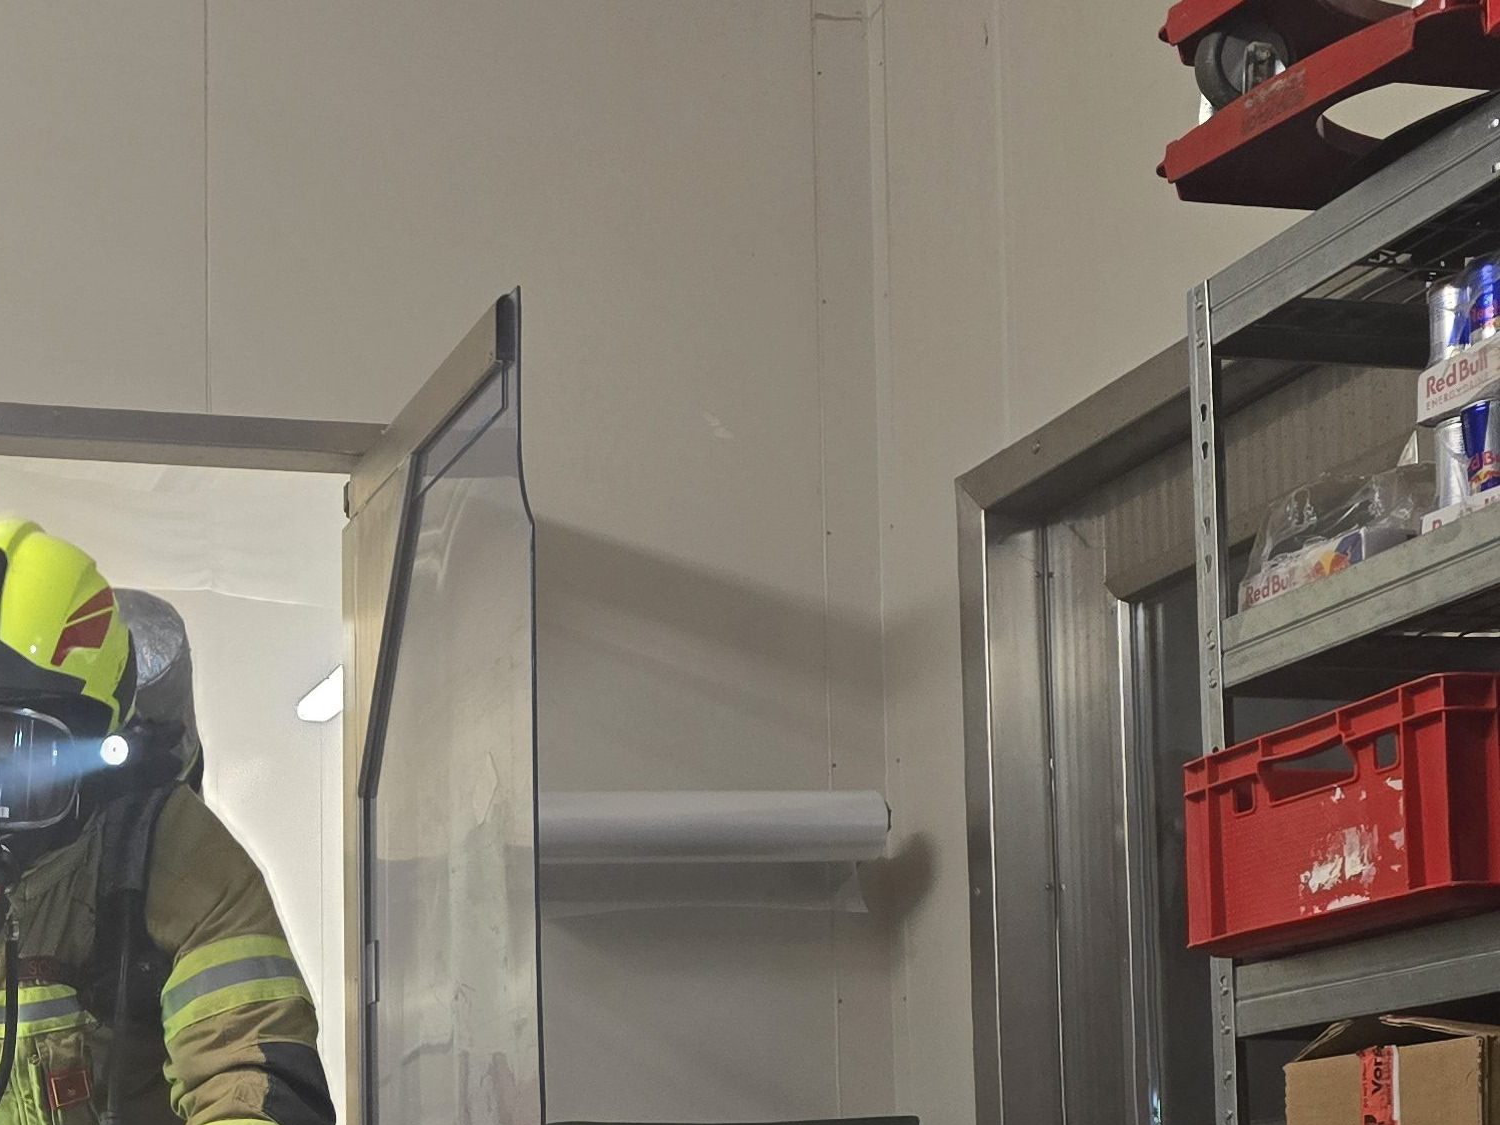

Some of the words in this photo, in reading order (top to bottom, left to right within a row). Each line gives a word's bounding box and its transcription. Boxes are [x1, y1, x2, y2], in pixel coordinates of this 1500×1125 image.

[1426, 363, 1457, 399] Red
[1459, 347, 1488, 382] Bull
[1245, 577, 1270, 606] Red
